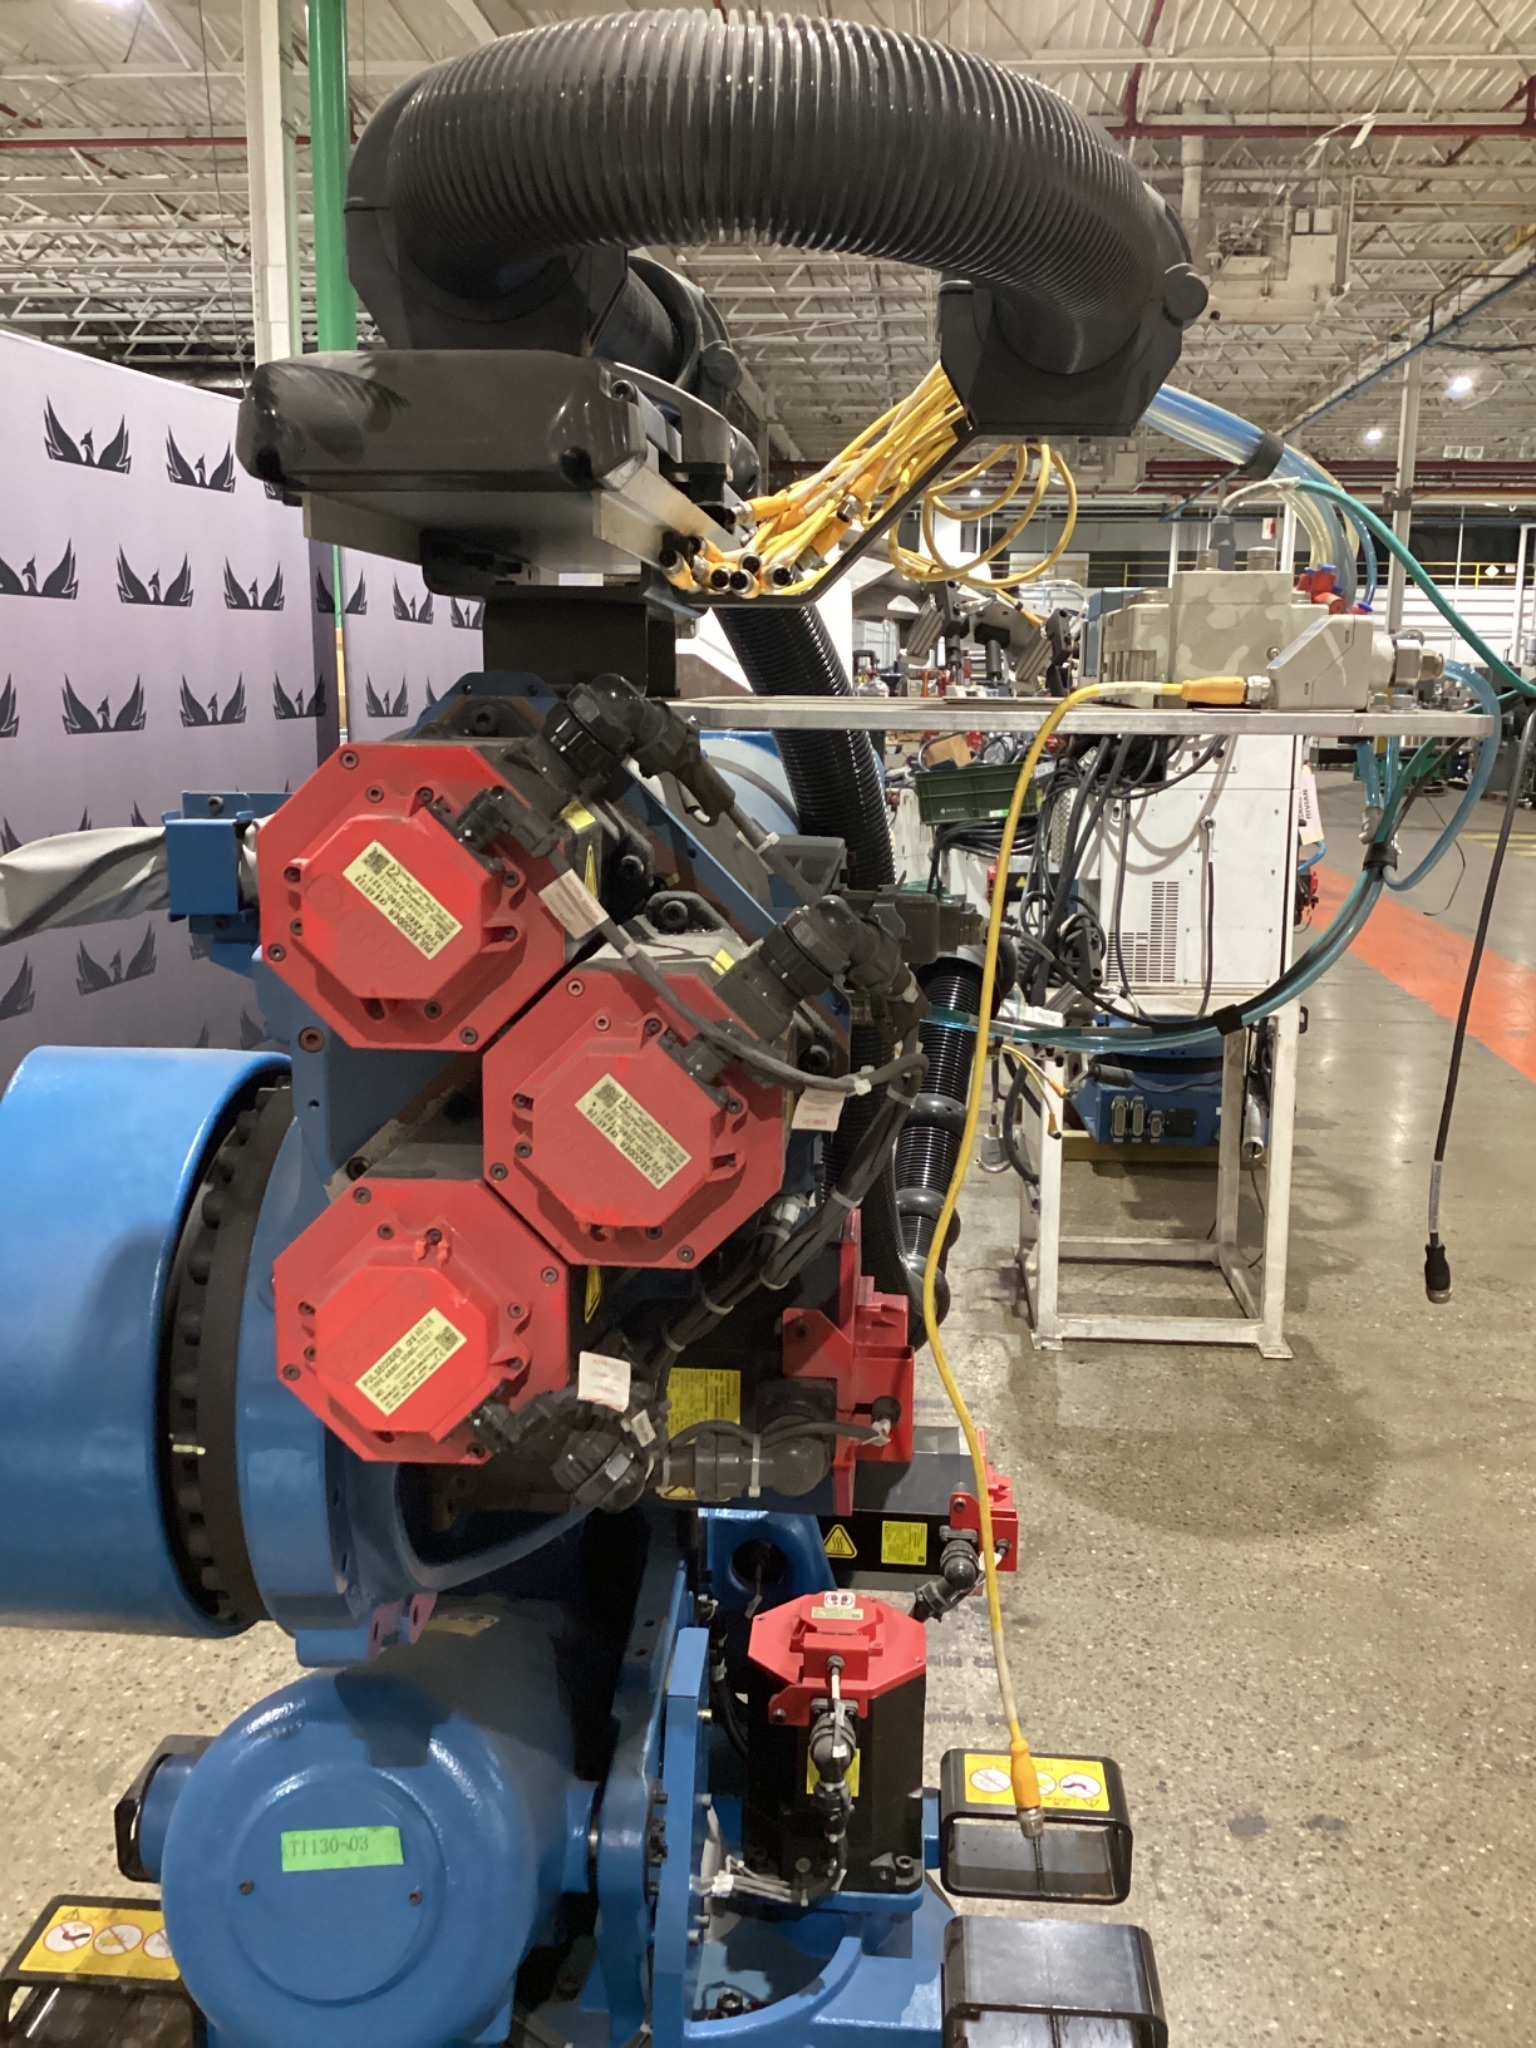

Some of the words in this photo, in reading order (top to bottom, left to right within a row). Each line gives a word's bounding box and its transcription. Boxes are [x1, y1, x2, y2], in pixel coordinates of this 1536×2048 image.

[1302, 789, 1312, 819] RIVIAN
[386, 907, 434, 954] PULSECODER
[421, 928, 439, 946] TYPE
[617, 1139, 664, 1185] PULSECODER
[651, 1159, 669, 1177] TYPE
[360, 1346, 404, 1387] PULSECODER
[368, 1376, 385, 1393] TYPE
[289, 1834, 369, 1857] T1130-03
